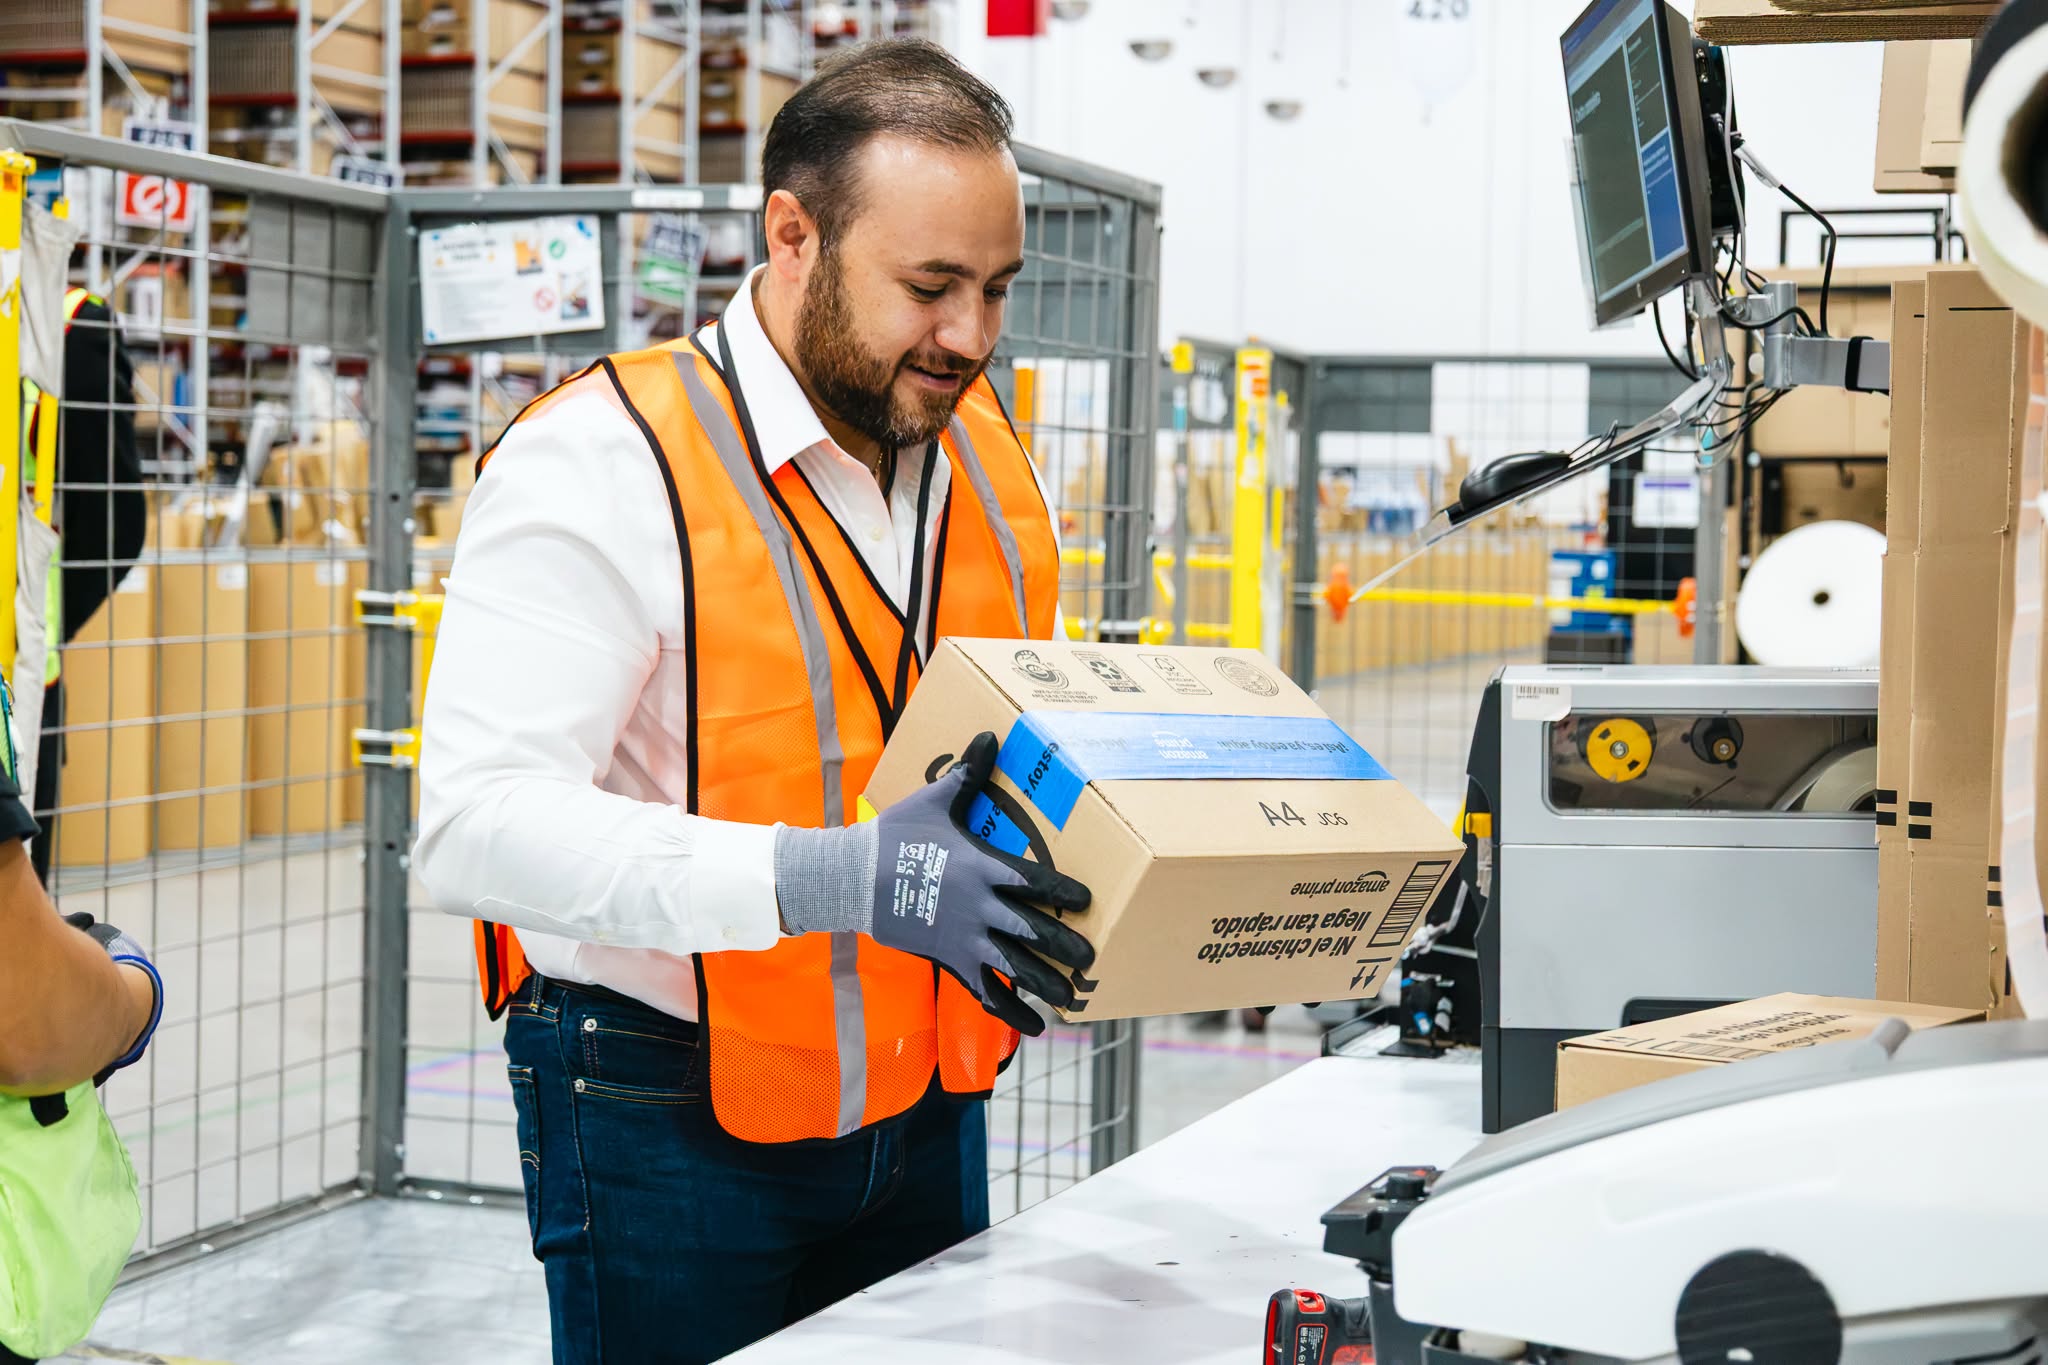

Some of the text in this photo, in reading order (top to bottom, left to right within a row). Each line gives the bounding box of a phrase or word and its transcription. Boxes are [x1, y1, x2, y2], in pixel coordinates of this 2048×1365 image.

[1152, 737, 1196, 751] prime
[1158, 749, 1210, 761] amazon
[1028, 742, 1060, 790] estoy
[1258, 801, 1349, 827] A4 JC6
[929, 847, 948, 883] Body
[1290, 878, 1391, 898] amazon prime
[915, 888, 926, 920] GEAR
[1211, 908, 1372, 938] llega tan rápido.
[1197, 935, 1357, 964] Ni el chismecito
